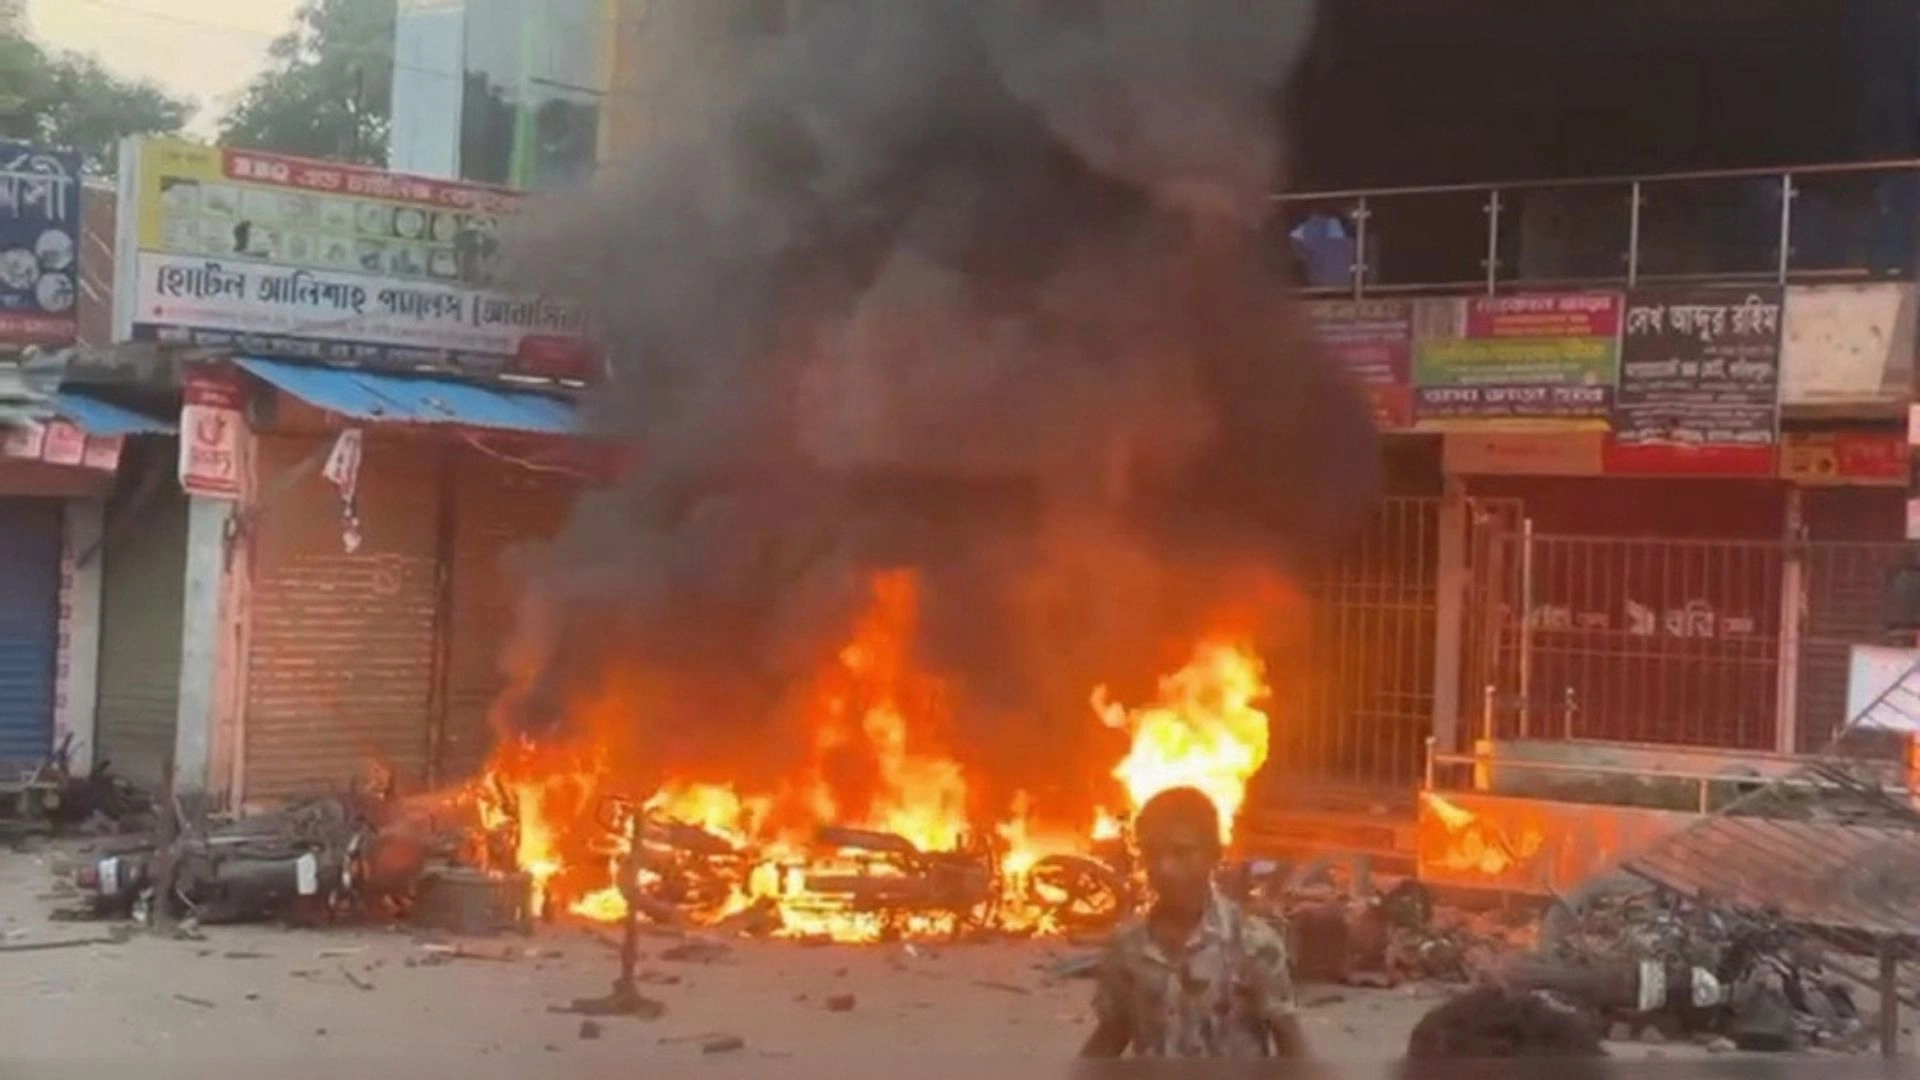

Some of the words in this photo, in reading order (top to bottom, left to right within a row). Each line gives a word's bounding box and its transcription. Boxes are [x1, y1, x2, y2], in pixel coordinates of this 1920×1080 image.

[157, 262, 246, 298] হোটেল
[258, 269, 368, 315] আলিশাহ
[377, 287, 462, 322] প্যালেস
